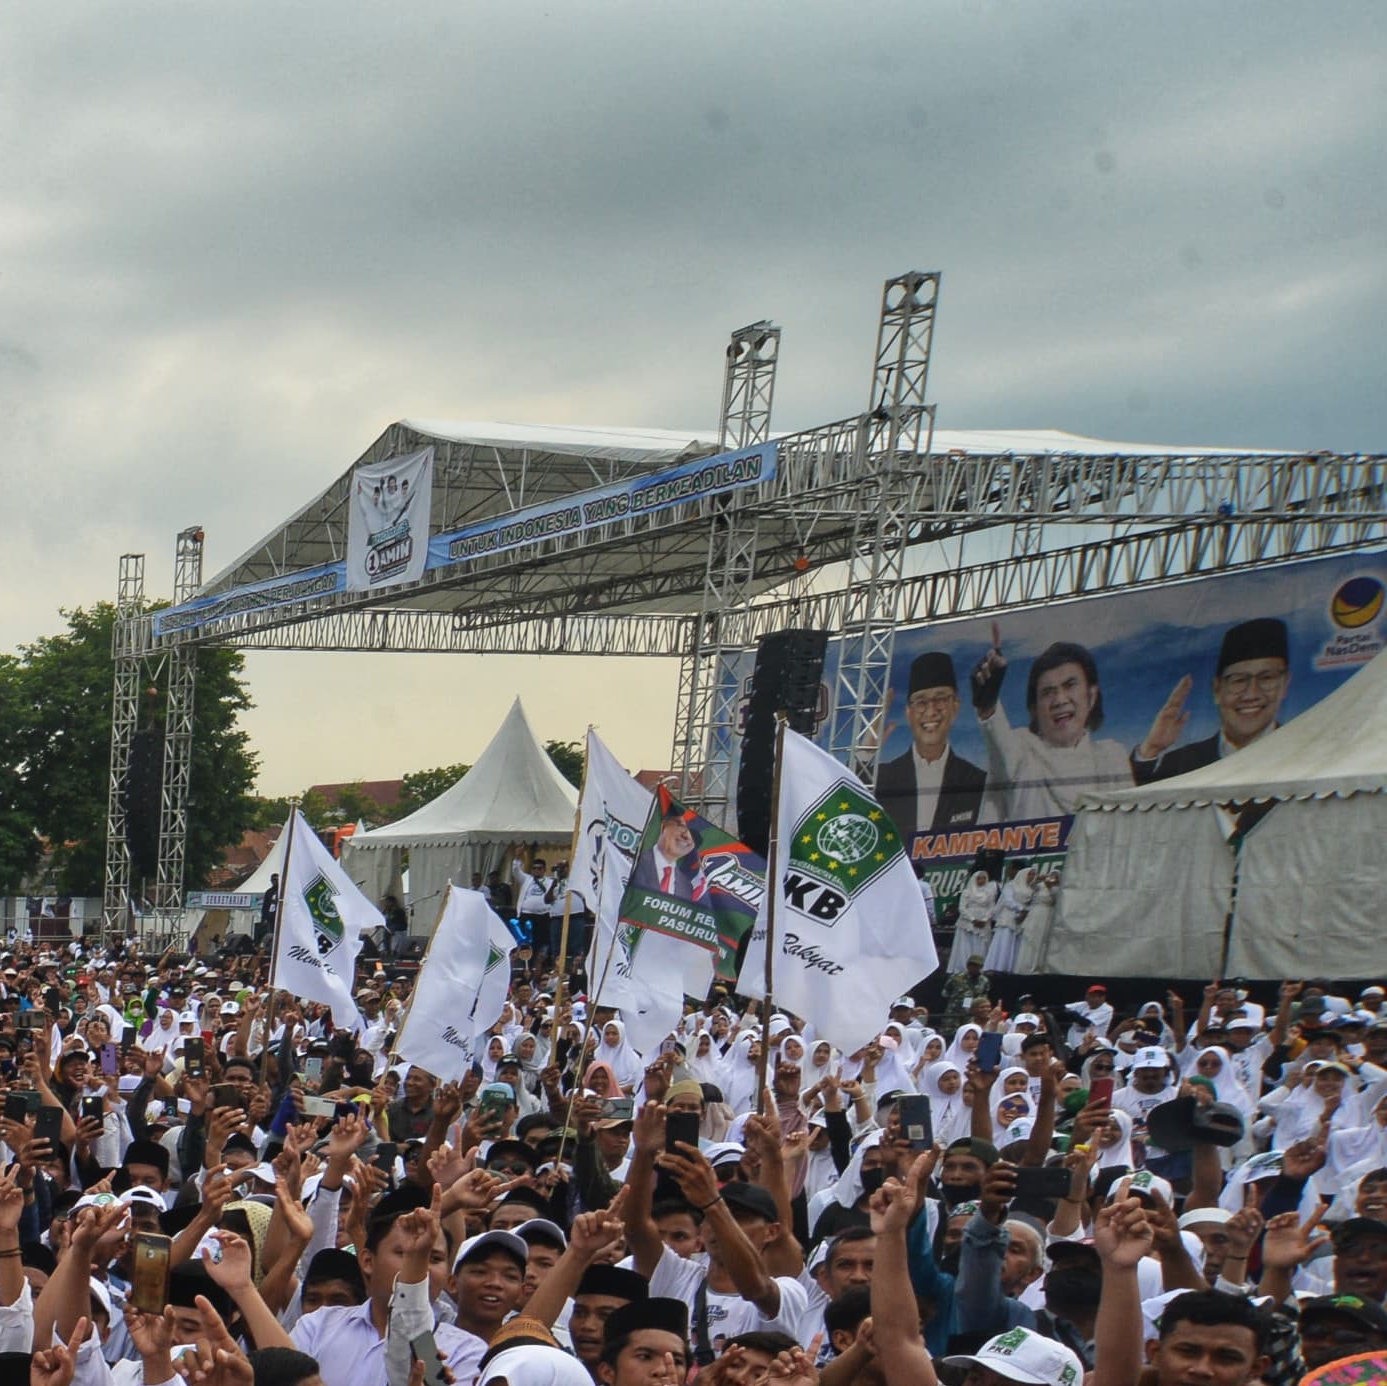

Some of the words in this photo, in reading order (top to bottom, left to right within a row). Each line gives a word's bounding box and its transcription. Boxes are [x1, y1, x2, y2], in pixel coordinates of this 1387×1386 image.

[449, 530, 498, 560] UNTUK
[498, 506, 581, 548] INDONESIA
[583, 493, 630, 525] YANG
[630, 453, 763, 513] BERKEADILAN
[380, 540, 412, 566] AMIN
[911, 821, 1062, 860] KAMPANYE
[206, 895, 248, 906] SEKRETARIAT
[642, 895, 692, 921] FORUM
[987, 1345, 1013, 1356] PKB
